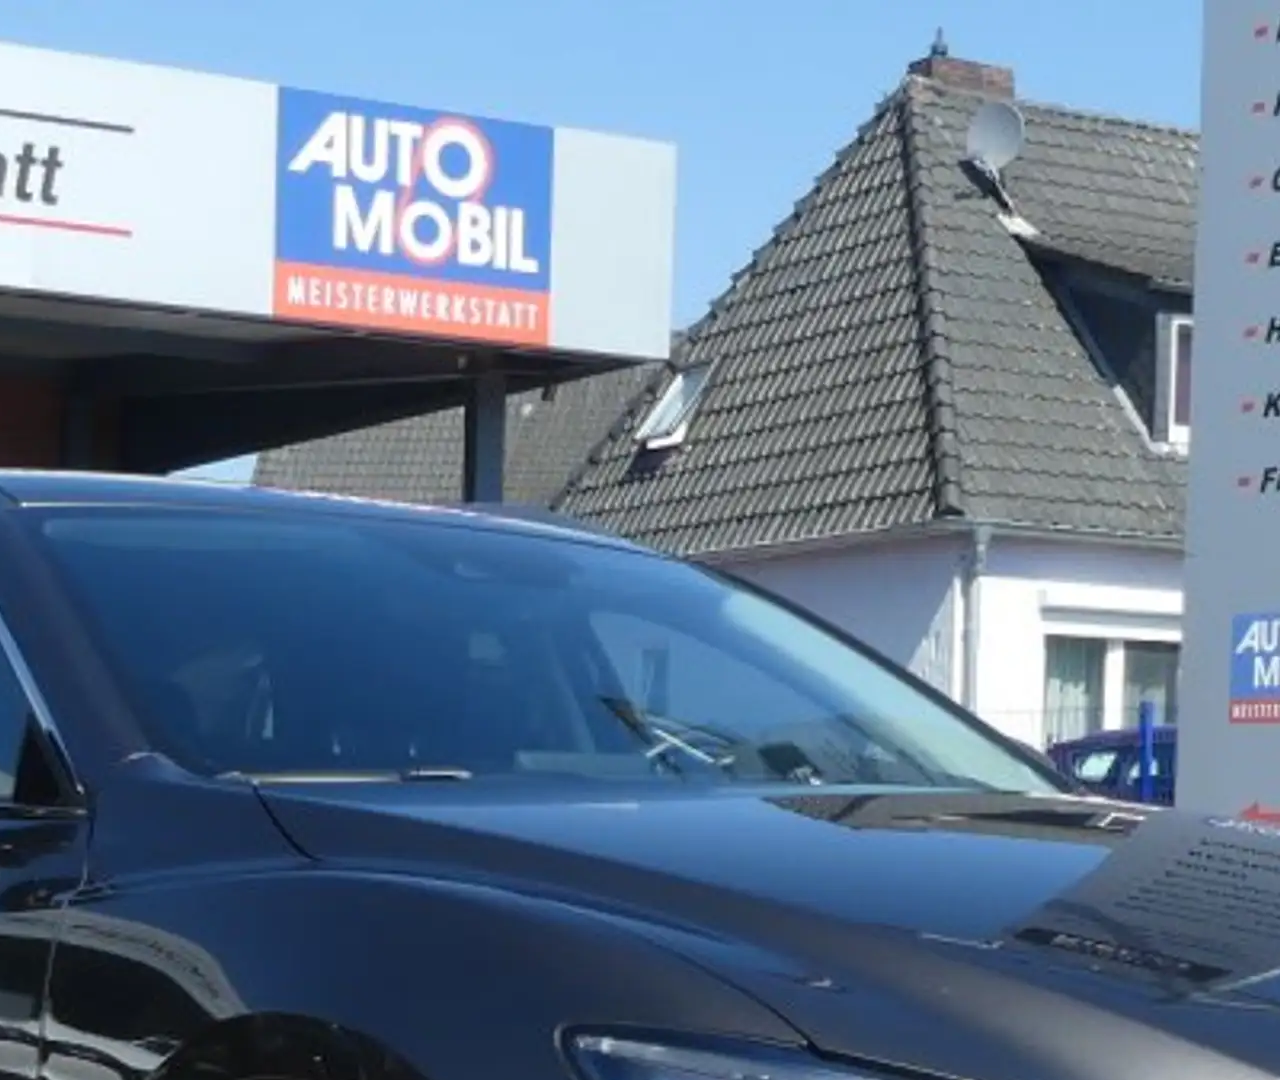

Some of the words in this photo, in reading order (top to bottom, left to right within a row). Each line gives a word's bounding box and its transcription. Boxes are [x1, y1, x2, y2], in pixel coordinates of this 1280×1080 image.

[287, 110, 489, 199] AUTO
[332, 184, 540, 274] MOBIL
[286, 276, 540, 331] MEISTERWERKSTATT
